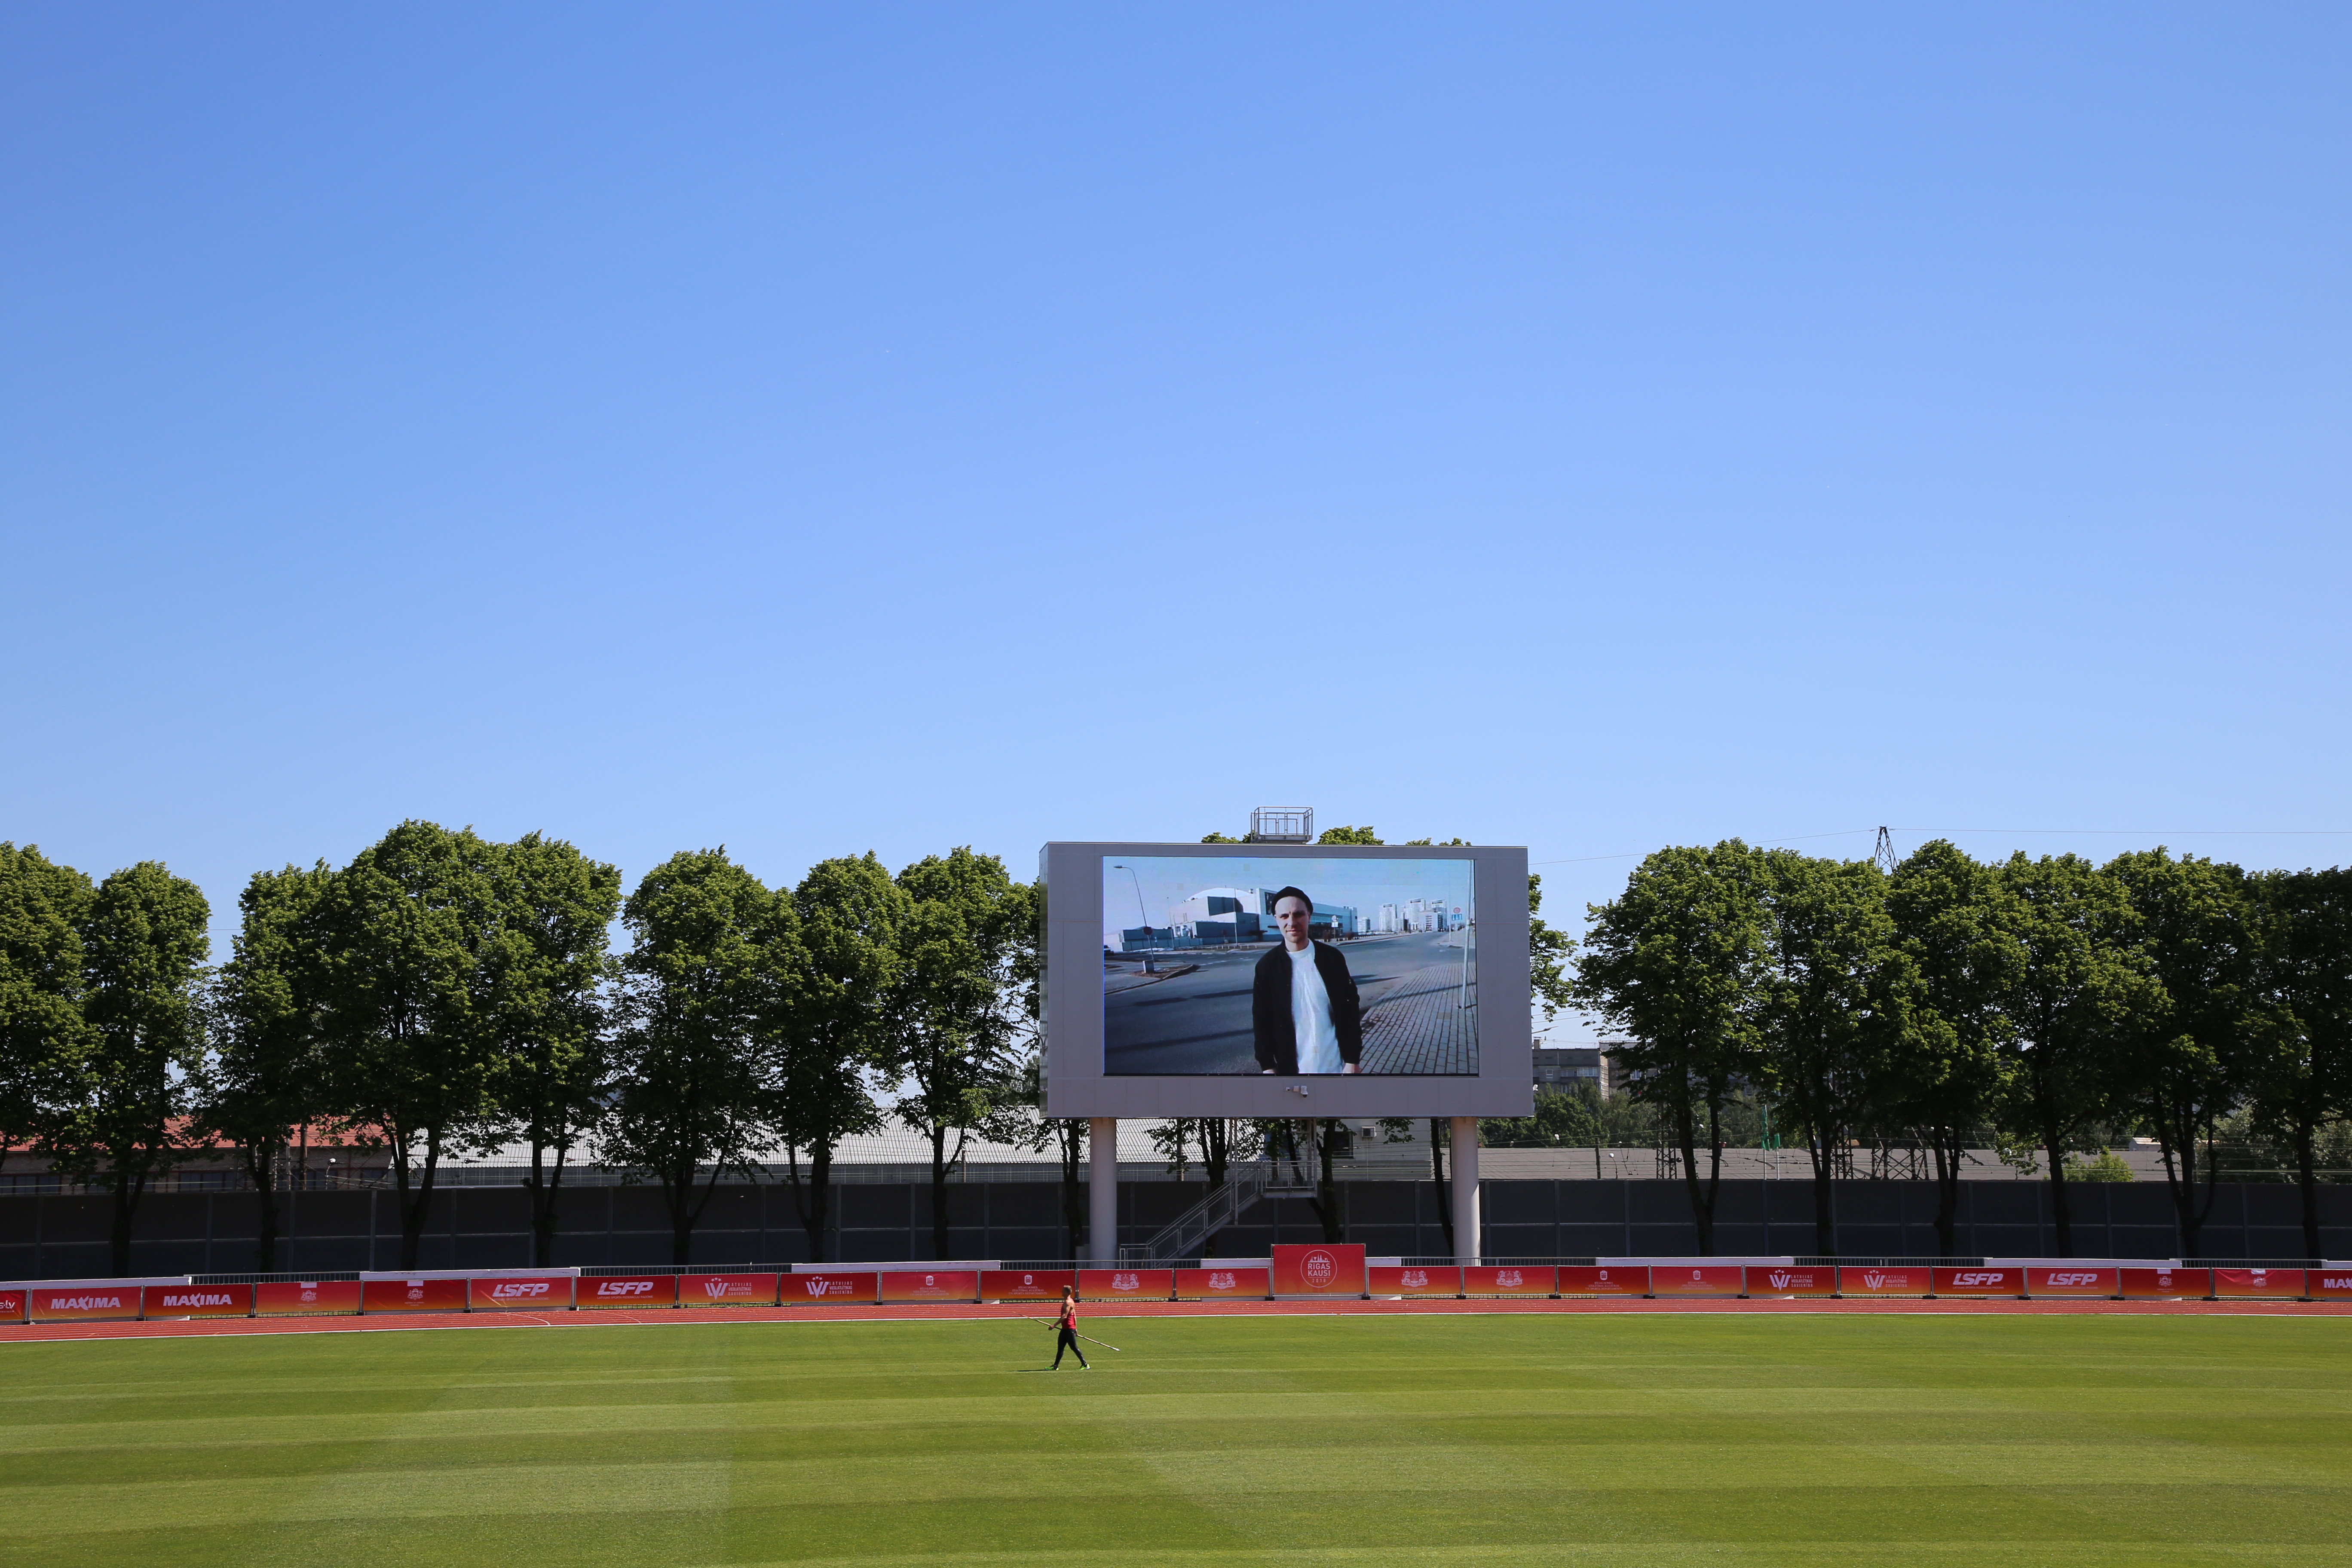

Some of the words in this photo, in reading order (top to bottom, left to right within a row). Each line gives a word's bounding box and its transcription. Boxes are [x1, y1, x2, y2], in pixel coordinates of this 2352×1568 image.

[1953, 1273, 2003, 1285] LSFP
[2047, 1273, 2098, 1285] LSFP
[492, 1283, 549, 1297] LSFP
[597, 1282, 653, 1295] LSFP
[51, 1295, 121, 1310] MAXIMA
[163, 1293, 232, 1308] MAXIMA
